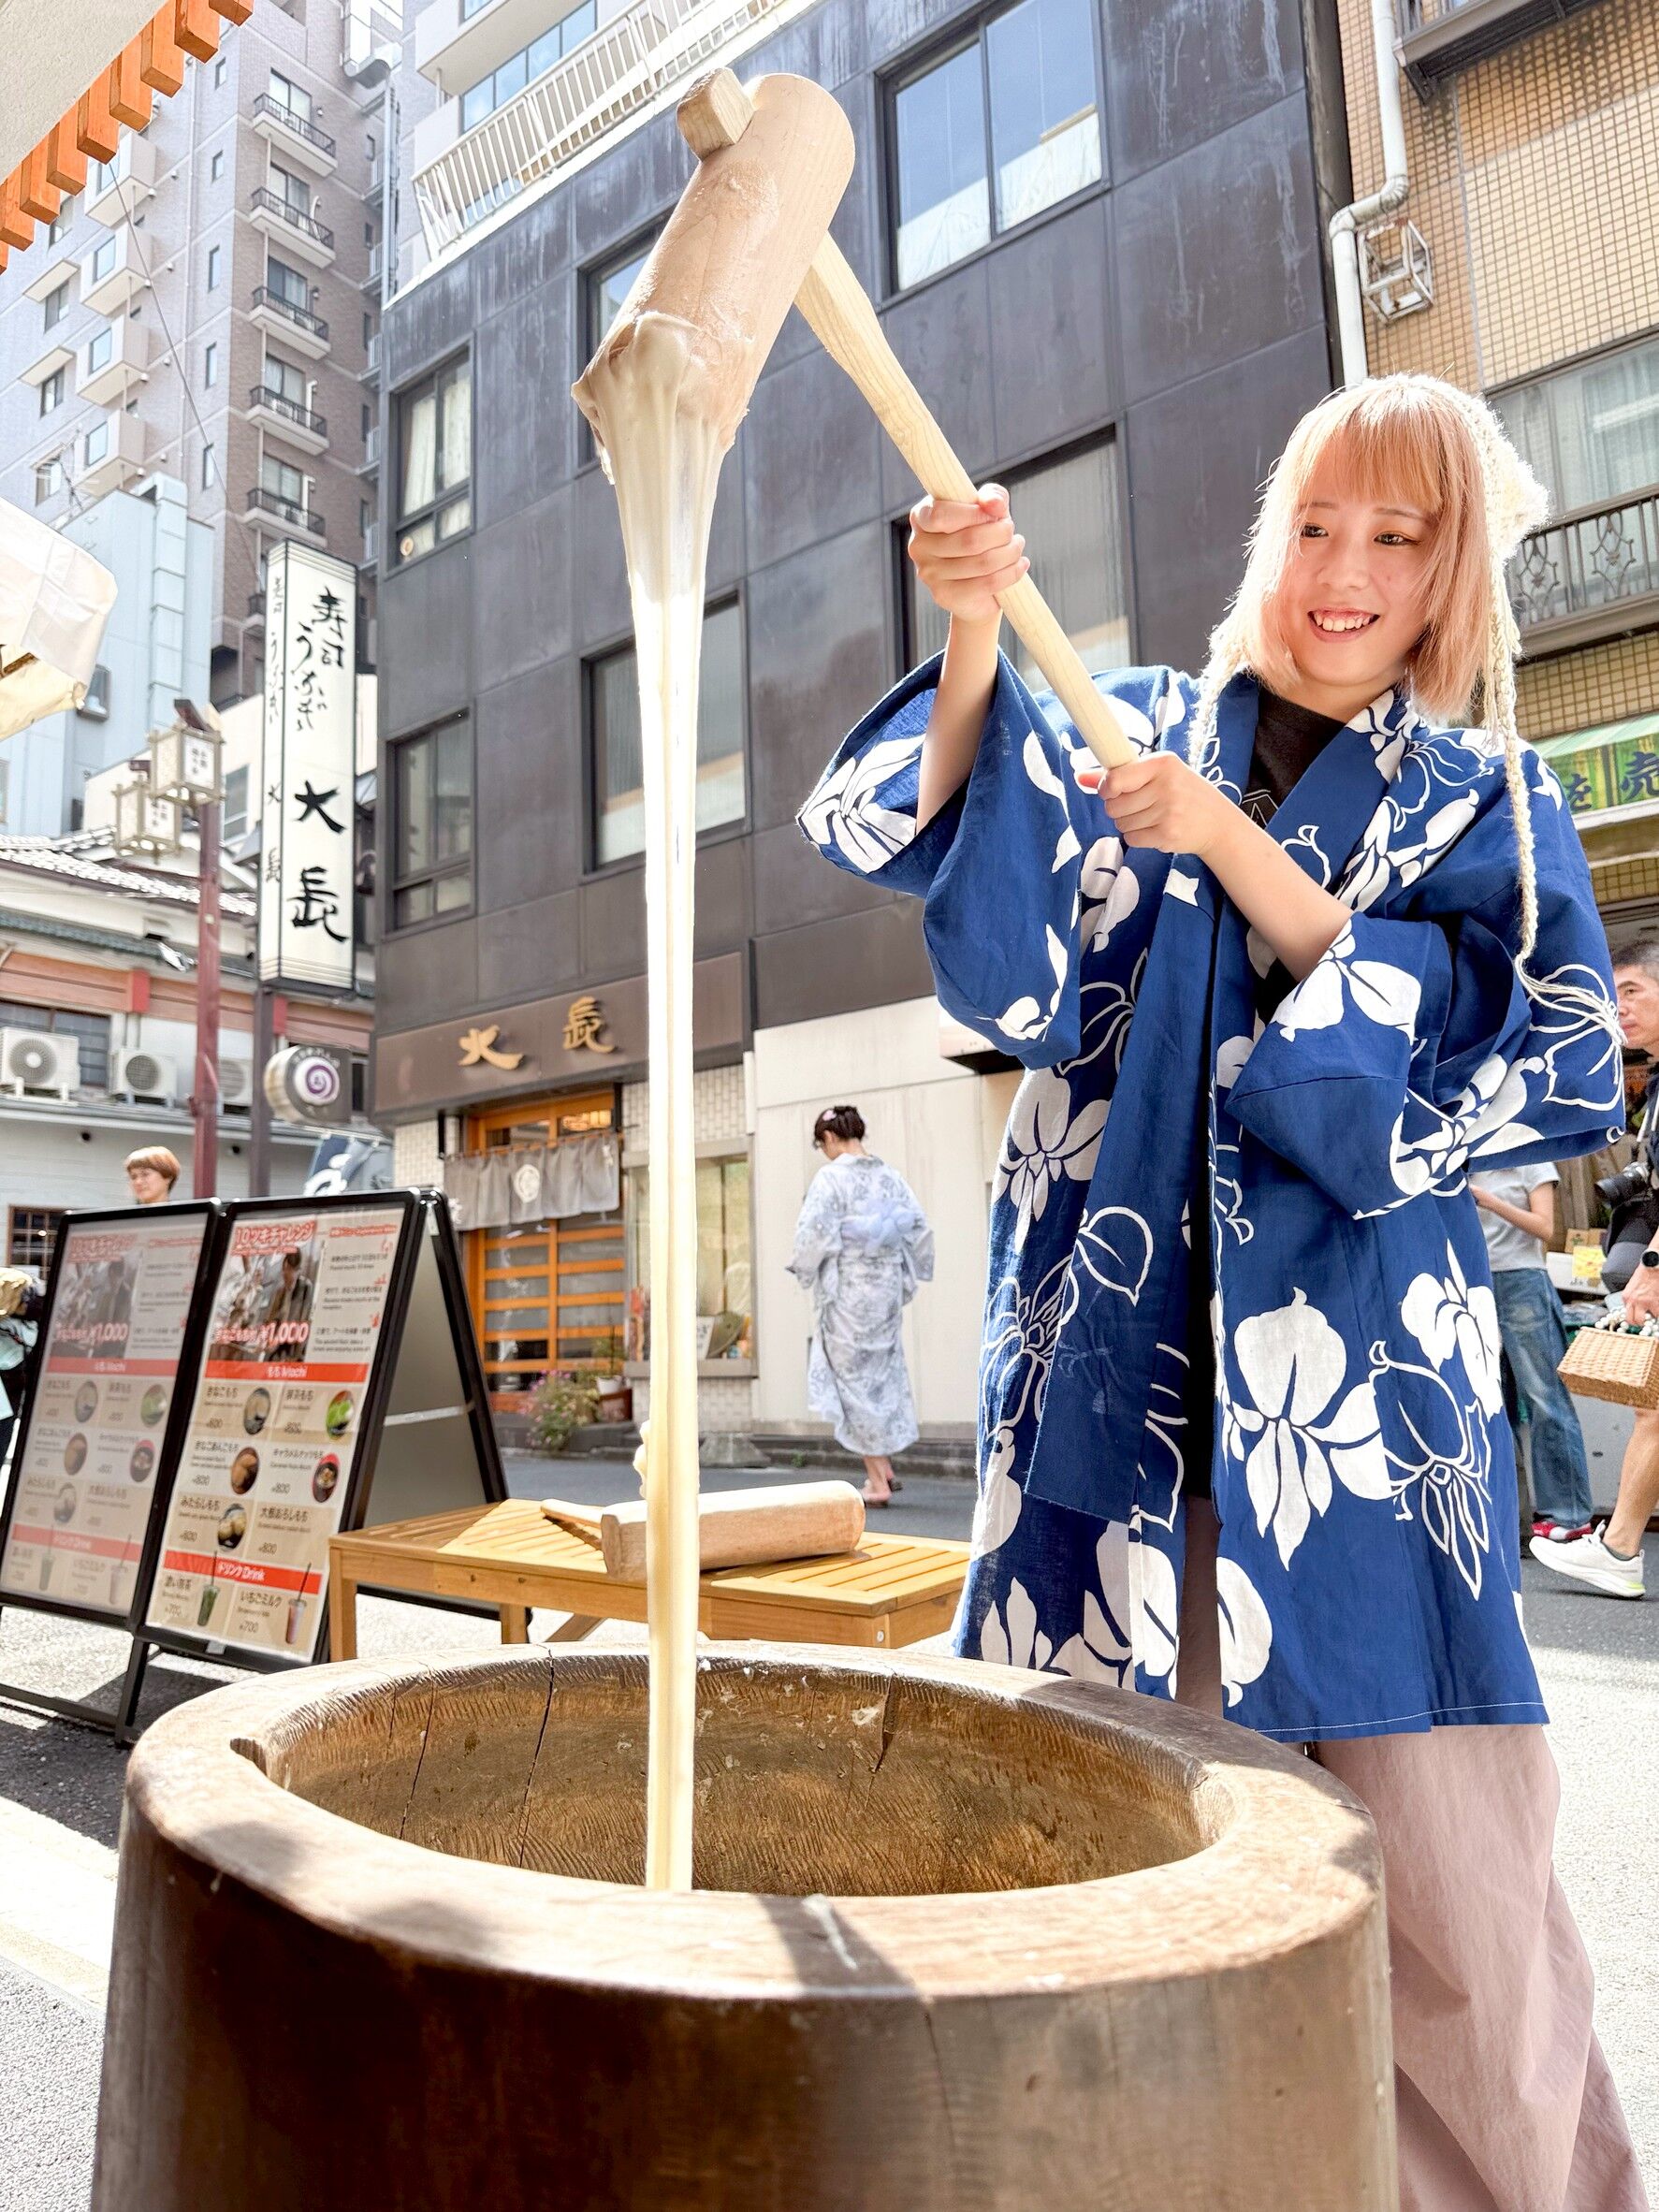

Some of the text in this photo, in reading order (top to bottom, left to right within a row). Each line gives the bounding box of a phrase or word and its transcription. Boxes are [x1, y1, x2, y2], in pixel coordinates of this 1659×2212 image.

[312, 586, 347, 669] 寿司
[290, 621, 327, 732] うなぎ
